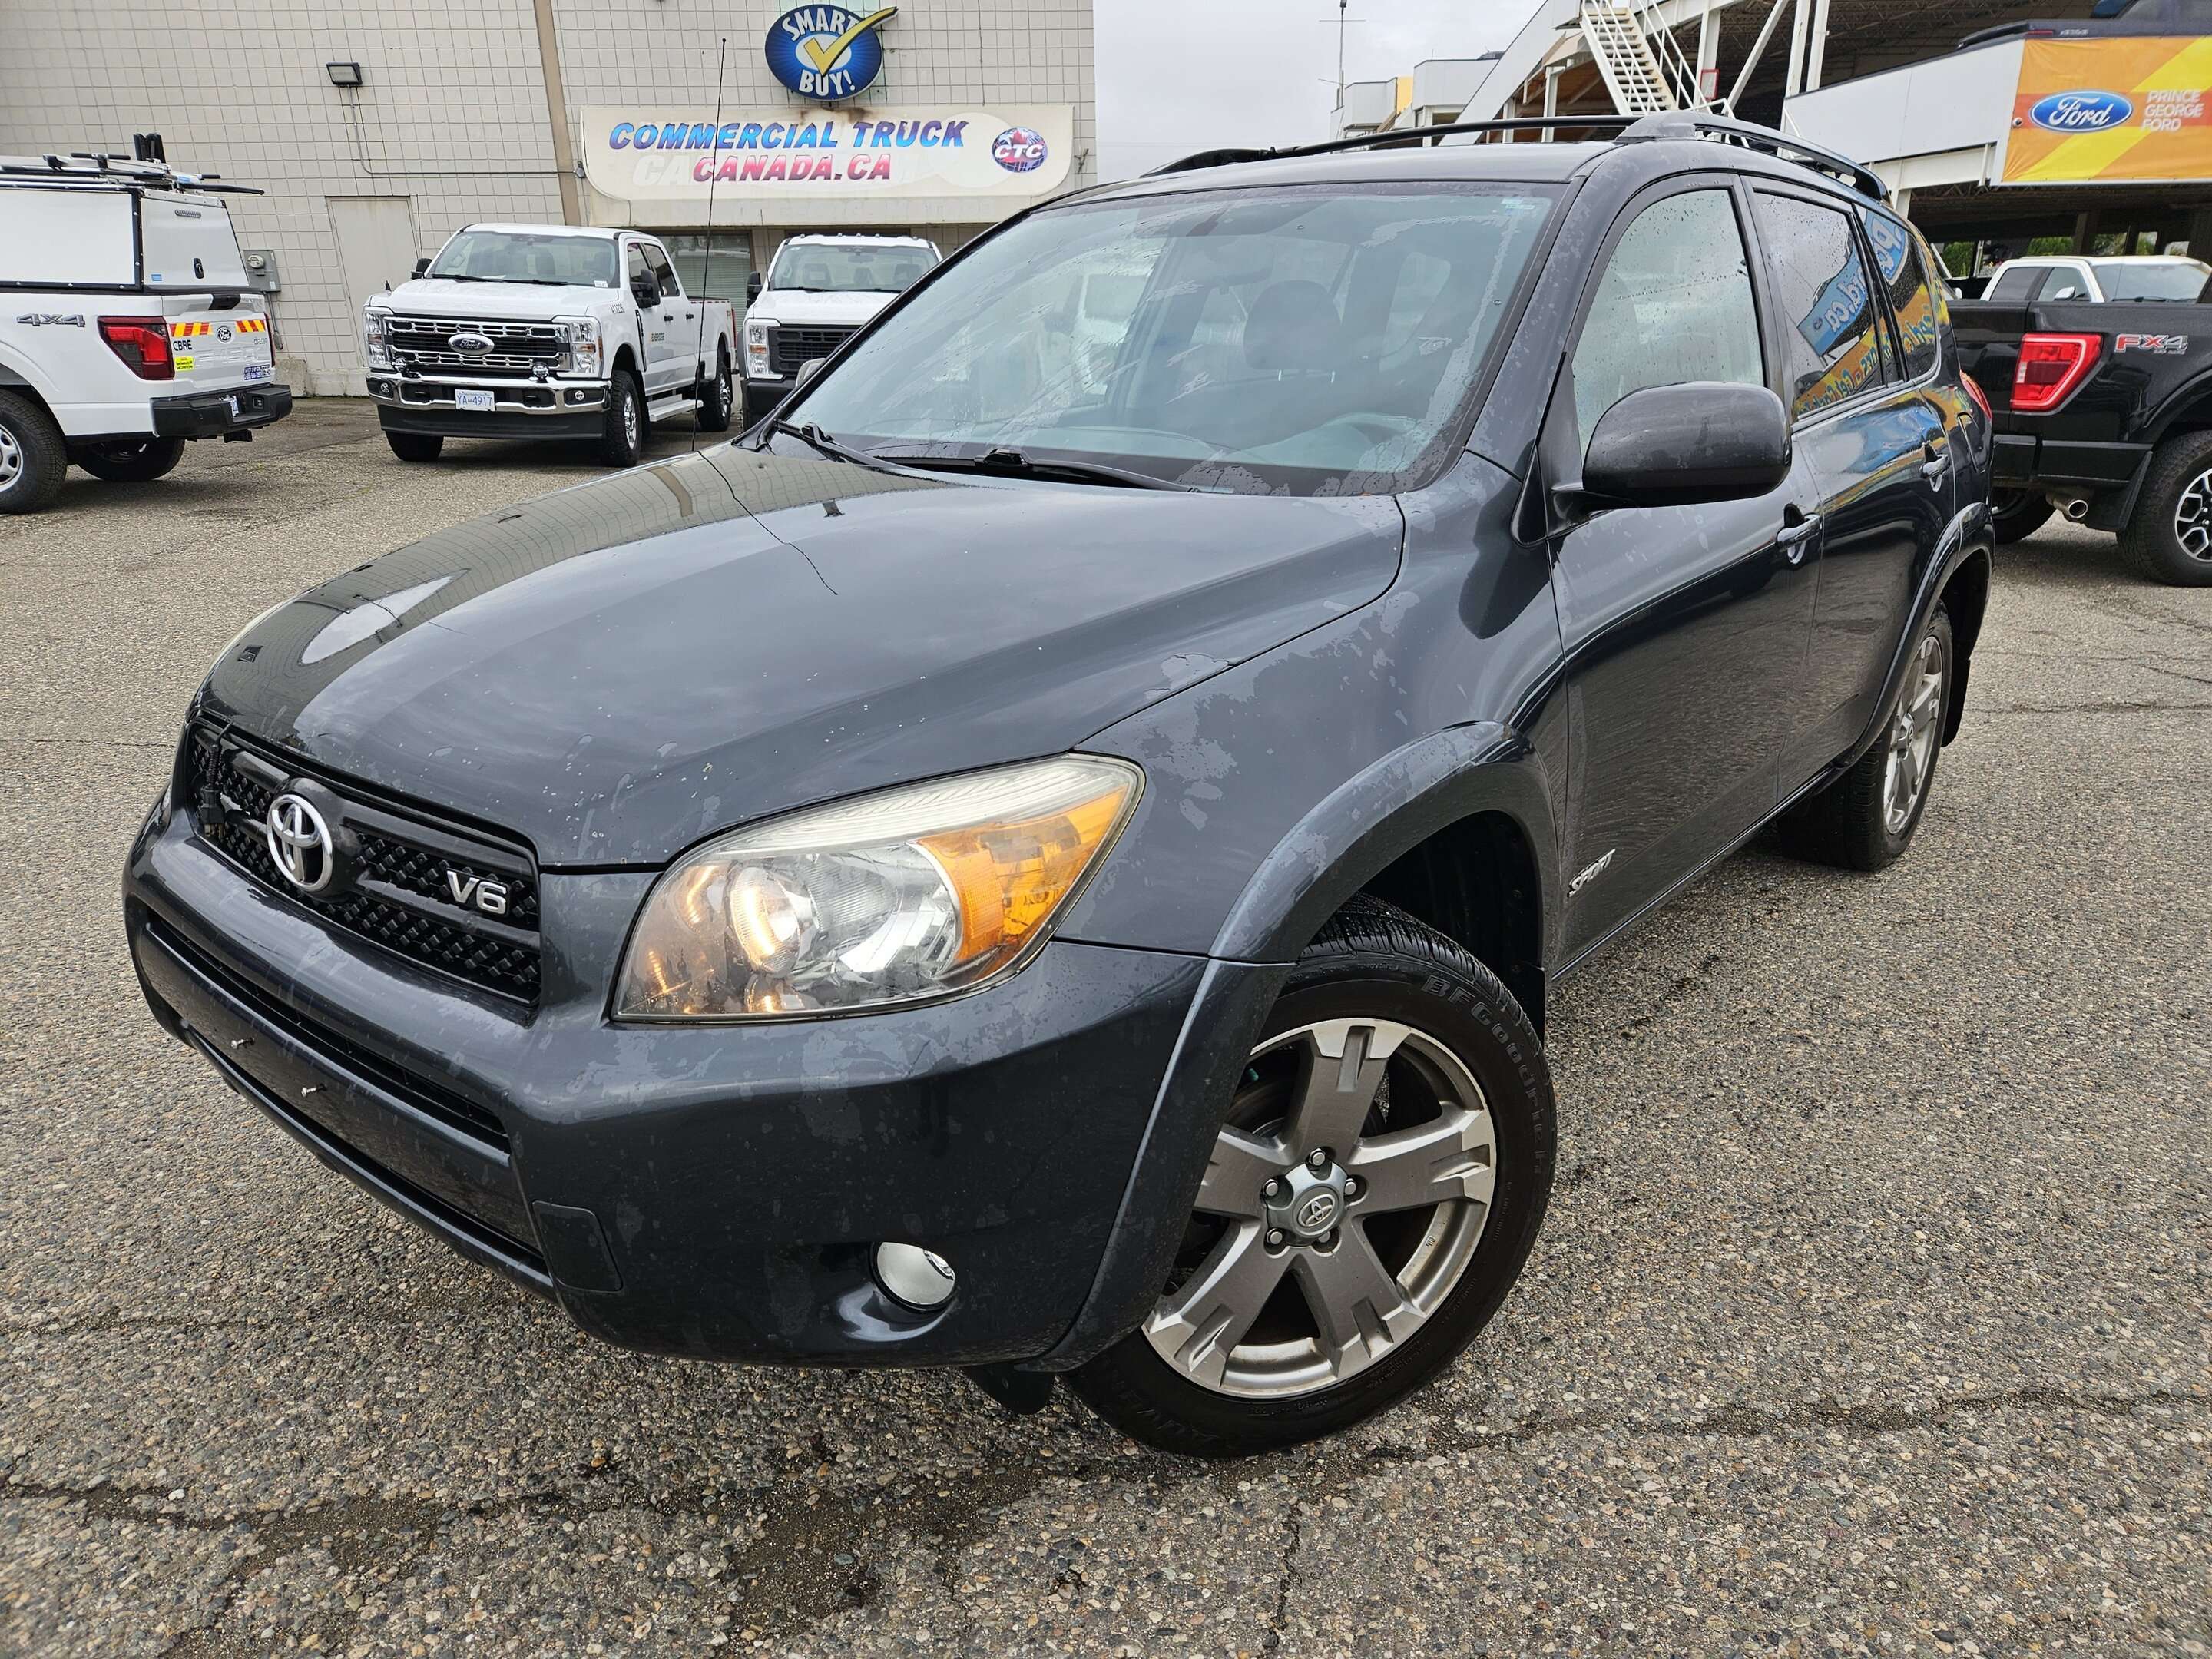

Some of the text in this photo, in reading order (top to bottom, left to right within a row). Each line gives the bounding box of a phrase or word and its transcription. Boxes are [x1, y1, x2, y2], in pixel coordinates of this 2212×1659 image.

[782, 8, 861, 41] SMART
[799, 69, 855, 97] BUY!
[2147, 90, 2201, 103] PRINCE
[2048, 96, 2114, 126] Ford
[2144, 104, 2204, 118] GEORGE
[609, 121, 970, 151] COMMERCIAL TRUCK
[2141, 118, 2182, 131] FORD
[994, 143, 1044, 159] CTC
[693, 153, 892, 182] CANADA.CA
[172, 339, 193, 352] CBRE
[2114, 333, 2188, 353] FX4
[446, 869, 508, 916] V6
